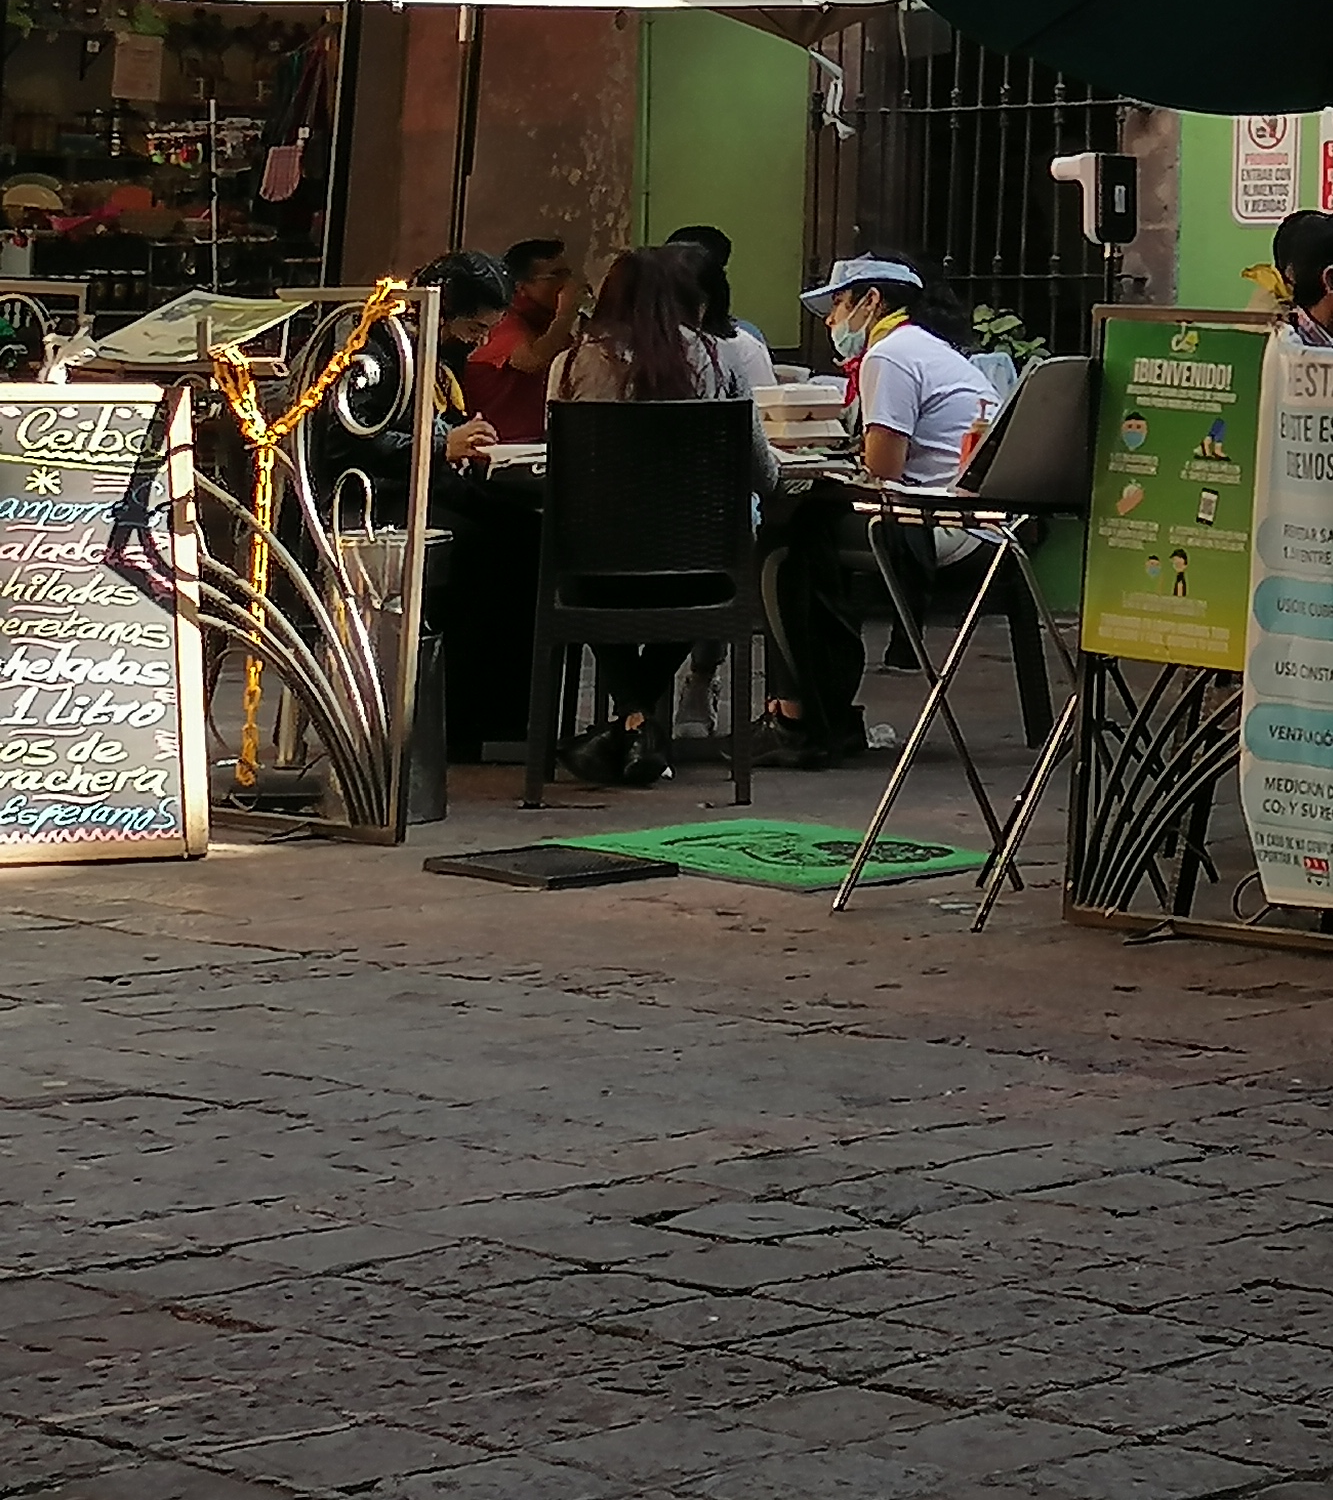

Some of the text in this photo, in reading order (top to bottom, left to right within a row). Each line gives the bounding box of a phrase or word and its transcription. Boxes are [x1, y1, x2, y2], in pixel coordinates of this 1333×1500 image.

[1133, 357, 1232, 391] ¡BIENVENIDO!
[0, 566, 140, 606] hiladas
[0, 640, 171, 686] heladas
[0, 686, 39, 725] 1
[0, 731, 130, 766] os de
[1289, 800, 1299, 815] Y
